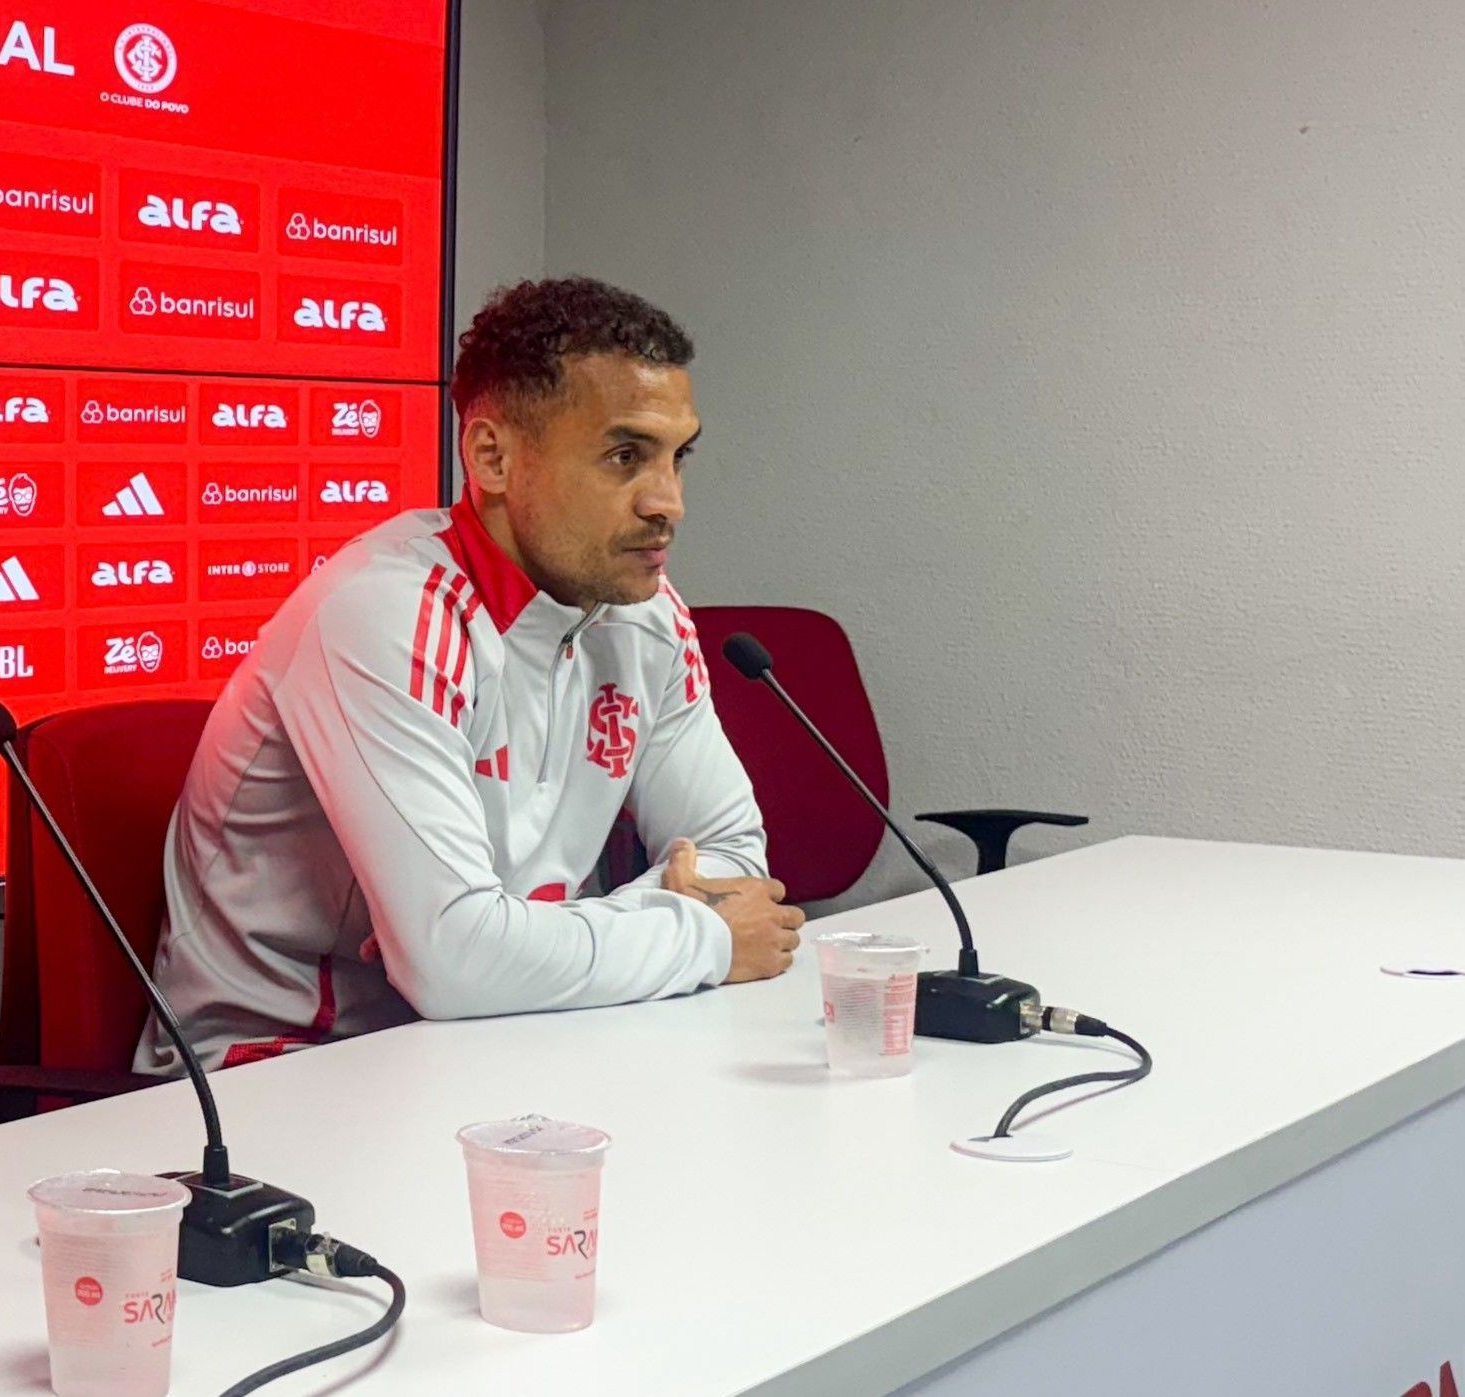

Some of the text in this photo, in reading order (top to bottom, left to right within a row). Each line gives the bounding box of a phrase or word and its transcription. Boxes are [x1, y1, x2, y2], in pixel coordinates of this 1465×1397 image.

[99, 92, 109, 102] O
[145, 98, 161, 110] DO
[161, 101, 190, 114] POVO
[313, 218, 397, 245] banrisul
[160, 292, 254, 319] banrisul
[106, 404, 186, 423] banrisul
[331, 402, 359, 428] Zé
[225, 486, 297, 502] banrisul
[207, 563, 290, 575] INTER STORE
[104, 636, 137, 665] Zé
